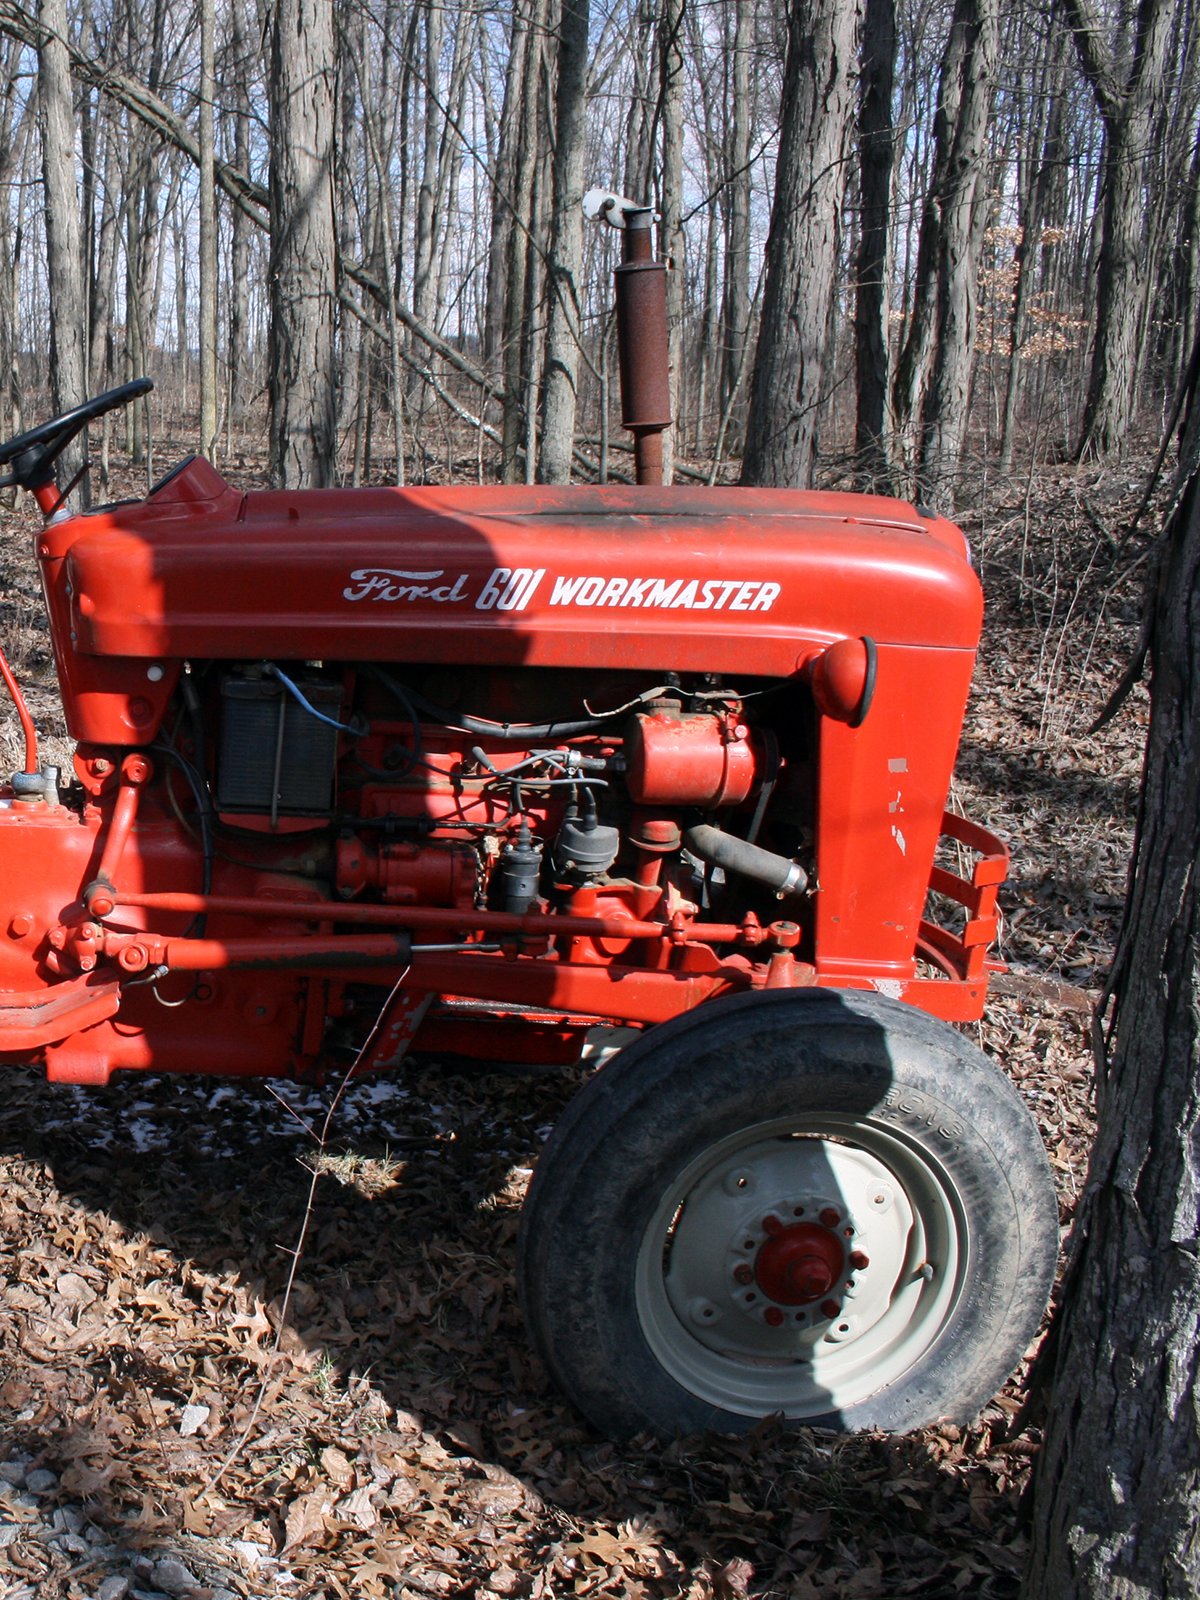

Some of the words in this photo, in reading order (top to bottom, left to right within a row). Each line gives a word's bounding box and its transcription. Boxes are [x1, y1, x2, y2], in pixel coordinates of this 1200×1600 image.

[343, 568, 469, 602] Ford
[475, 568, 547, 611] 601
[548, 576, 783, 611] WORKMASTER
